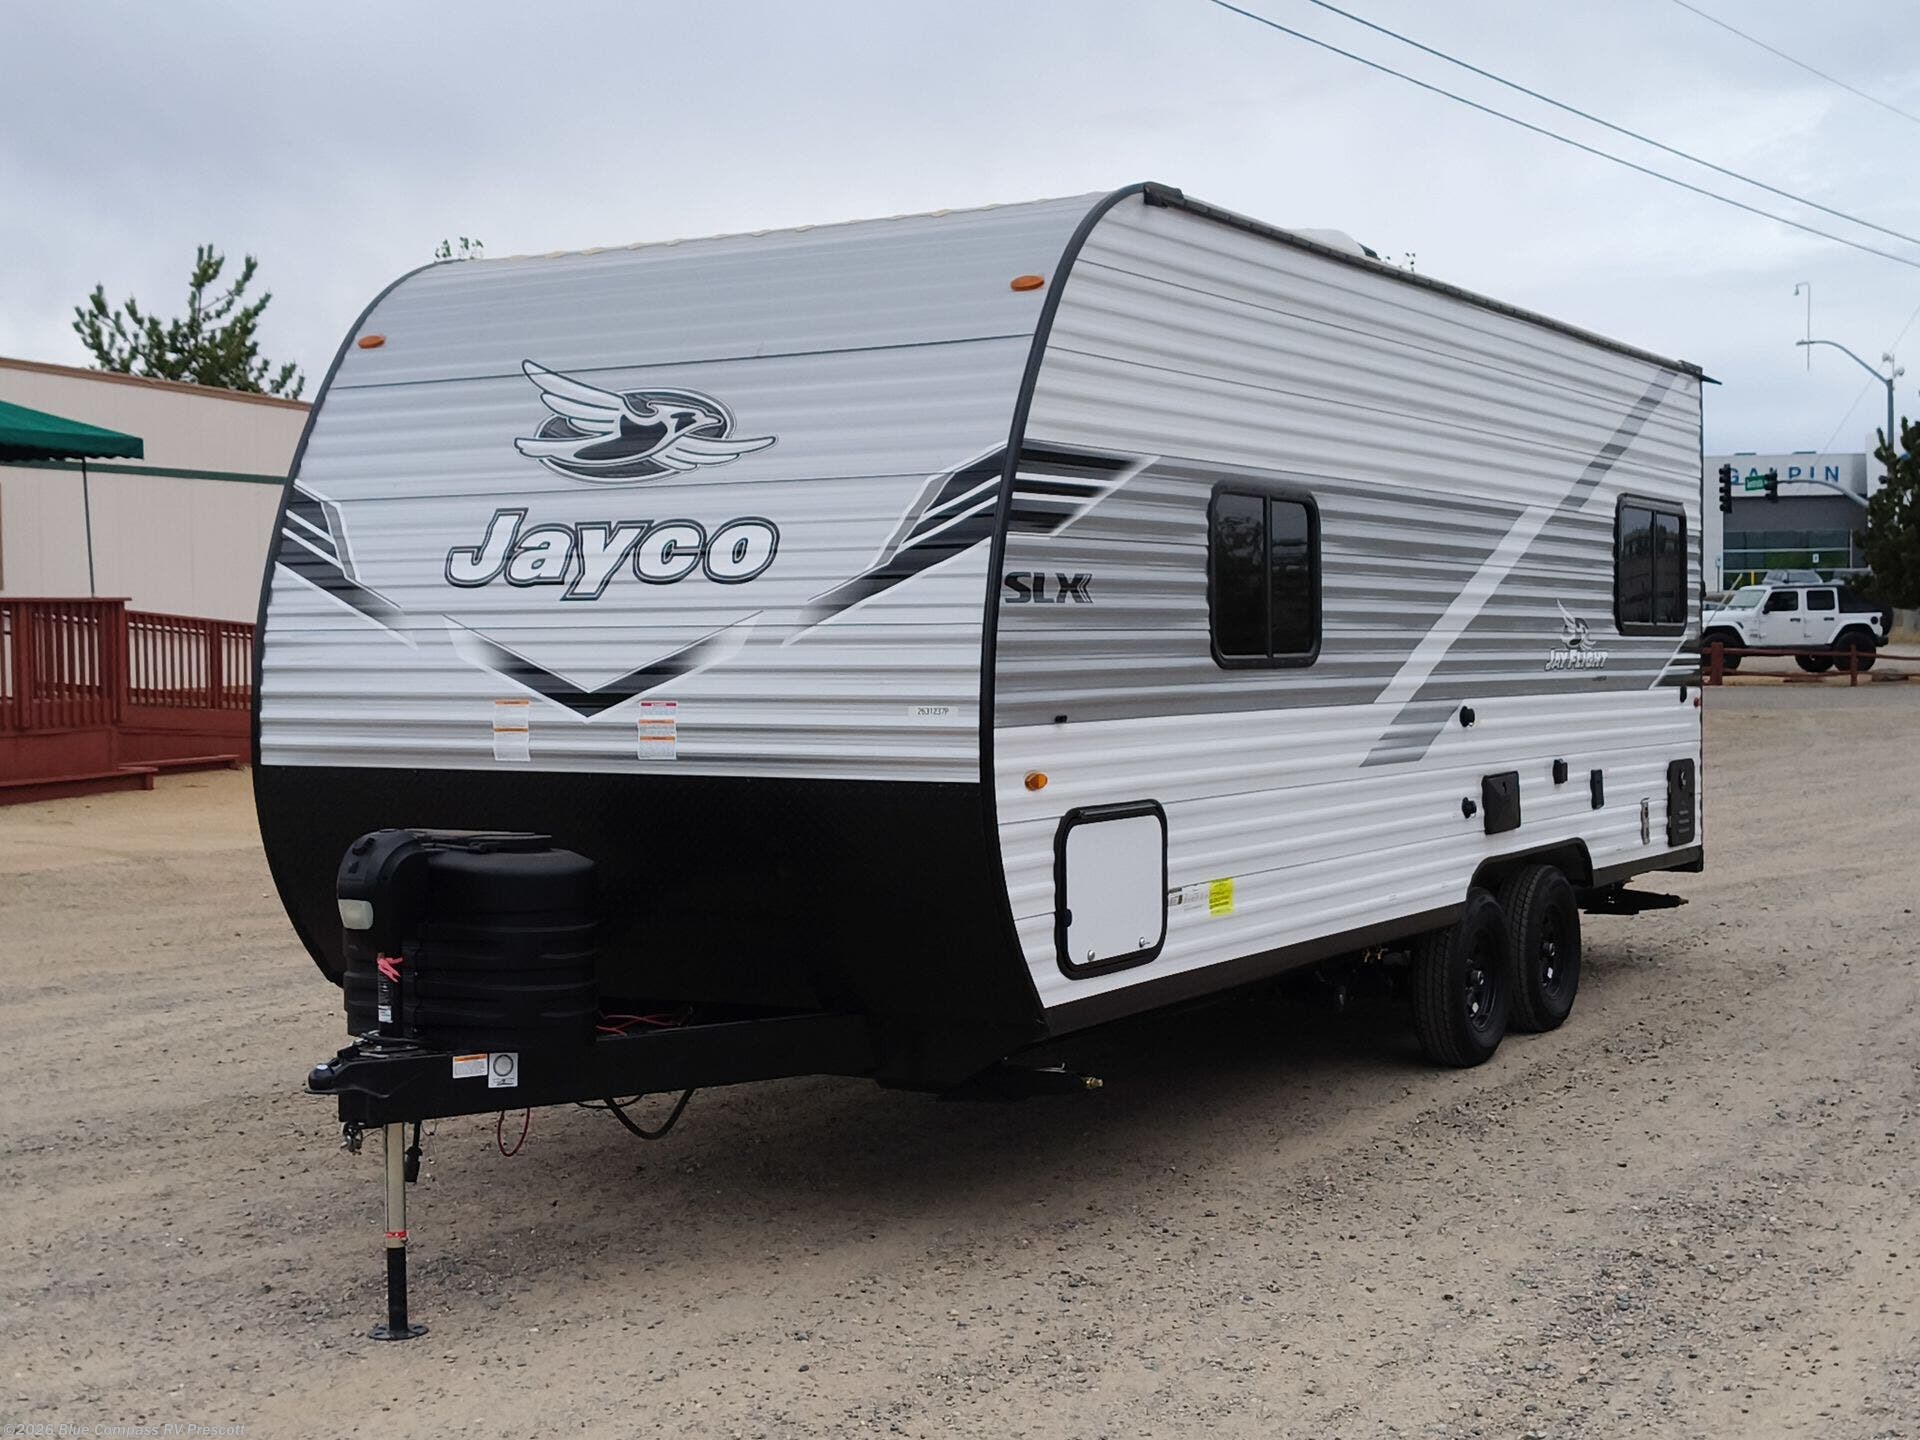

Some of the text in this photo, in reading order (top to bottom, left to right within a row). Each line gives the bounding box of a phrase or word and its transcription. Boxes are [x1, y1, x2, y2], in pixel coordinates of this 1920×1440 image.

[1731, 466, 1840, 485] GAPIN
[444, 508, 780, 601] Jayco
[1004, 571, 1093, 603] SLX
[1567, 650, 1608, 670] FLIGHT
